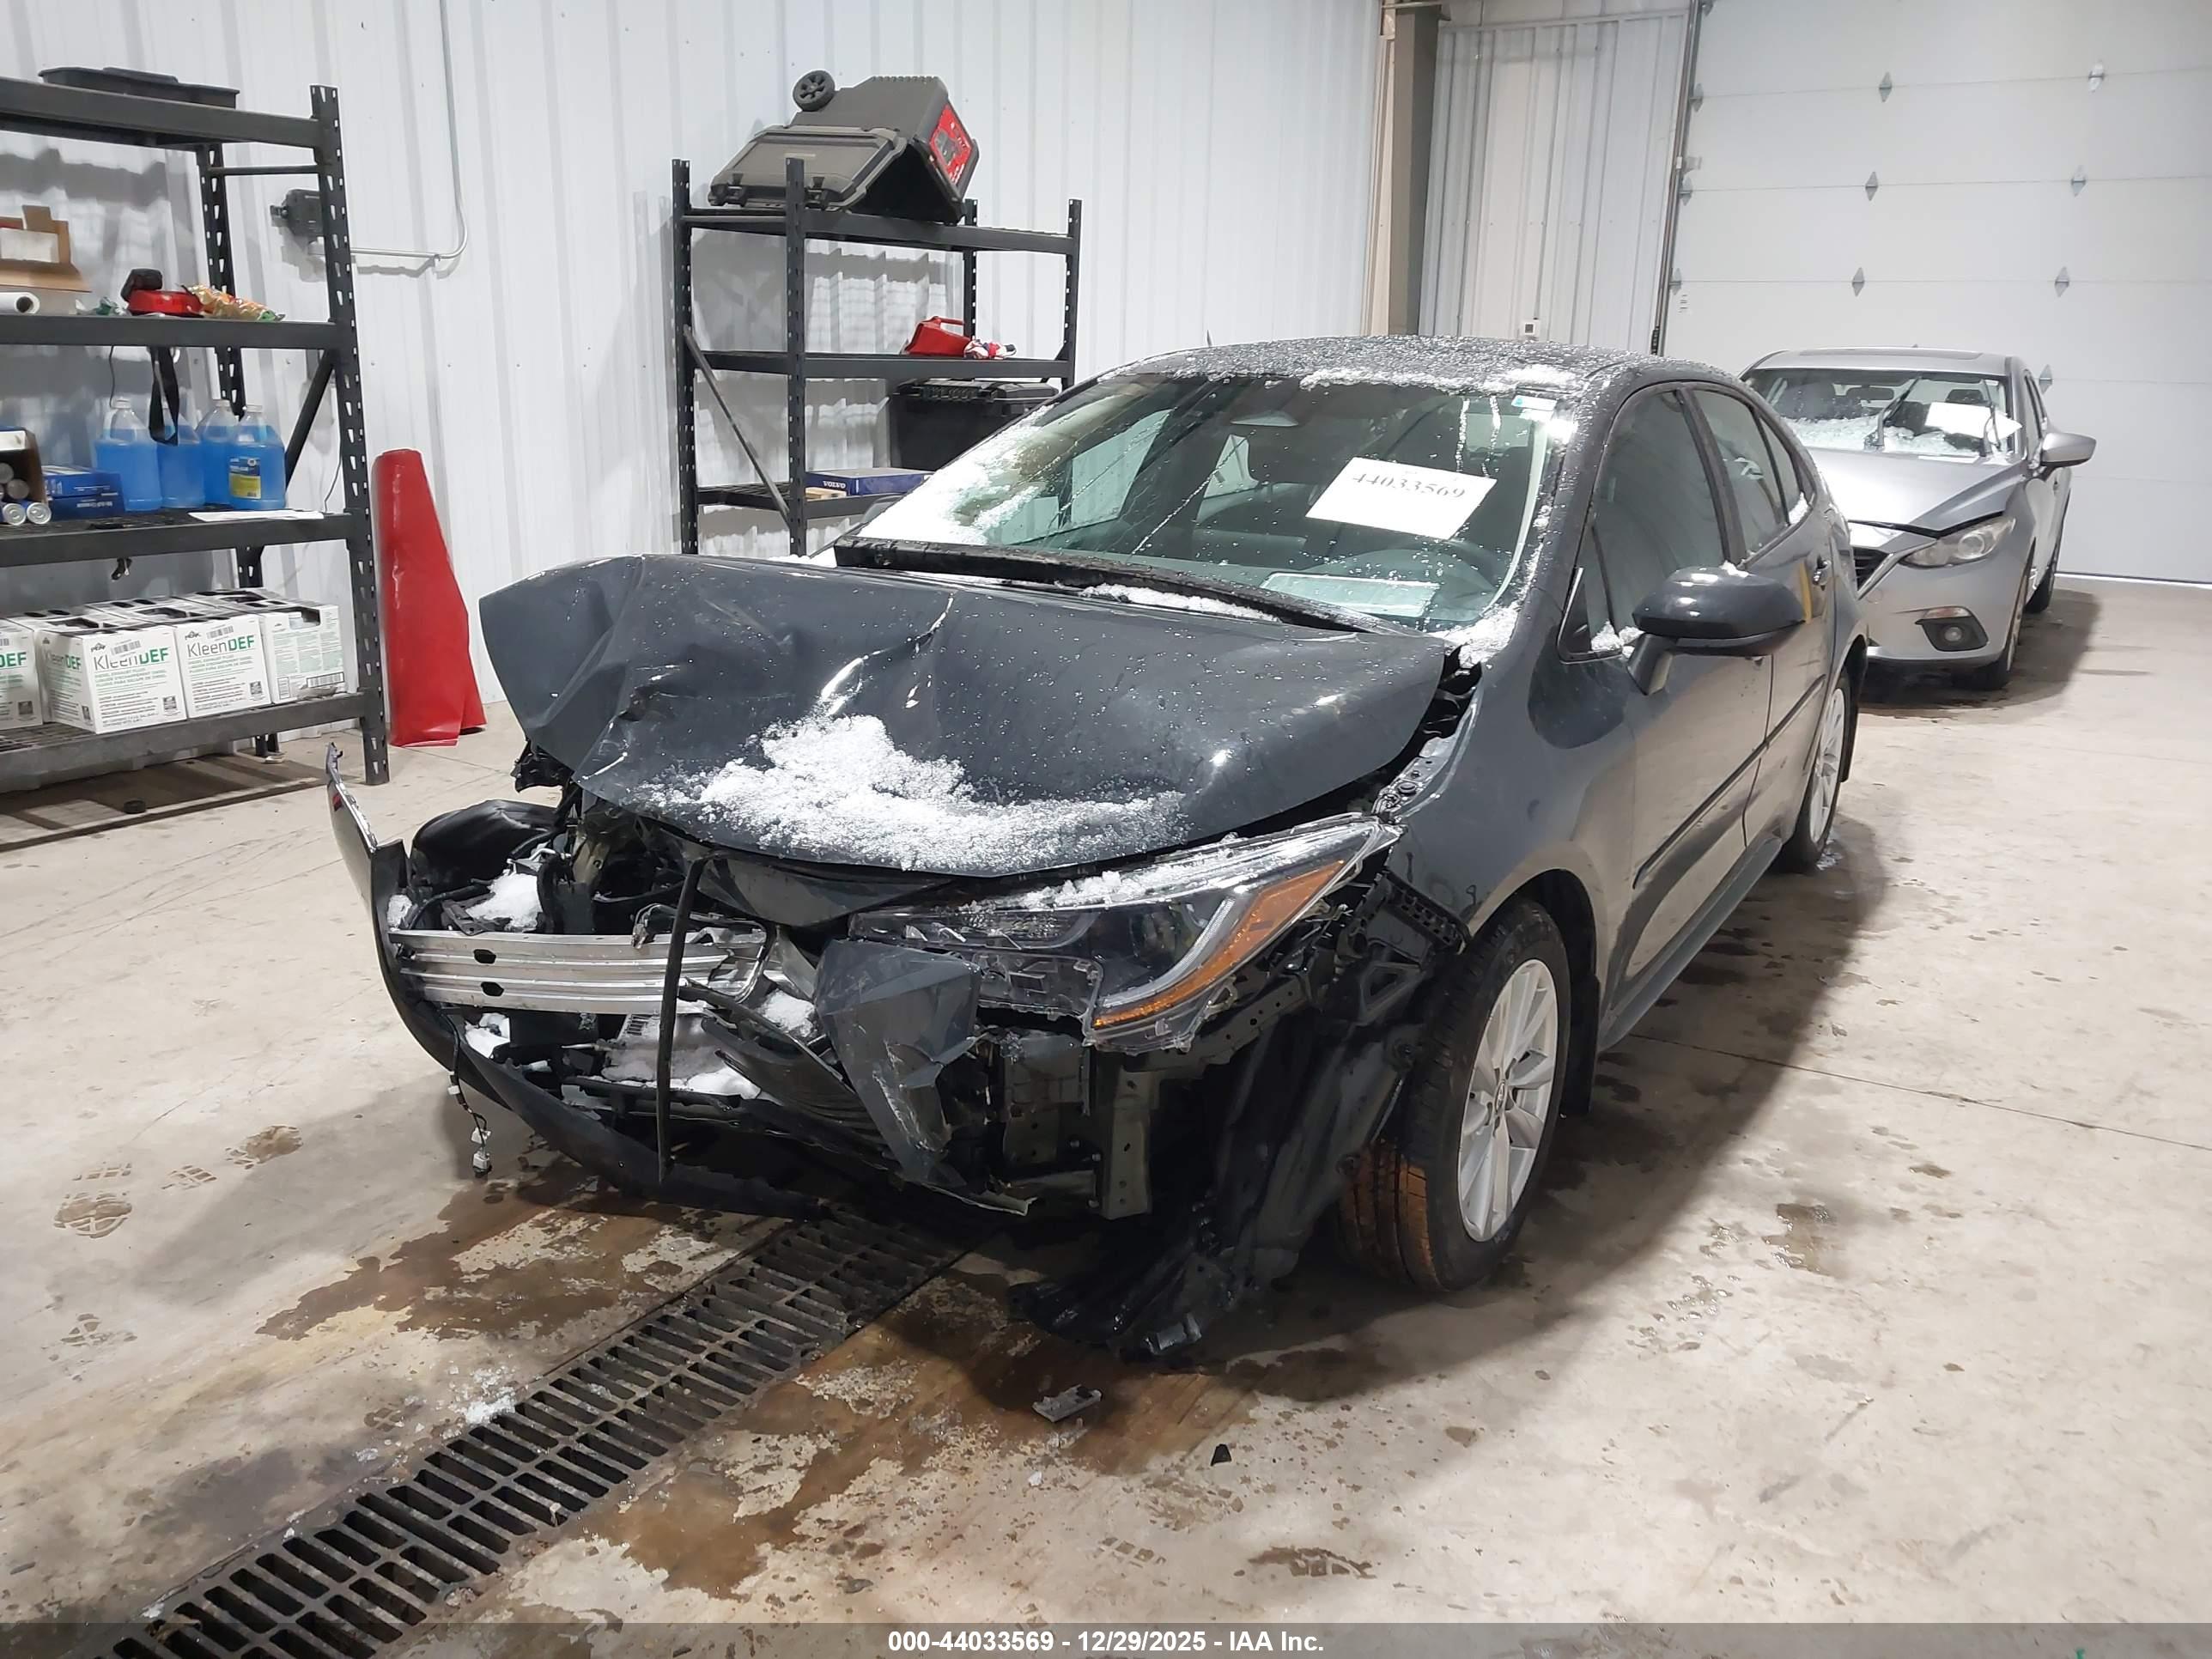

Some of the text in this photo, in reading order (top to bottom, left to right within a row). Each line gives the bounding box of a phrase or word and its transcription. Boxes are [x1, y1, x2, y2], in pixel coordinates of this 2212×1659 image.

[823, 480, 847, 489] VOLVO
[1352, 473, 1466, 498] 44033569
[186, 635, 255, 658] KleenDEF
